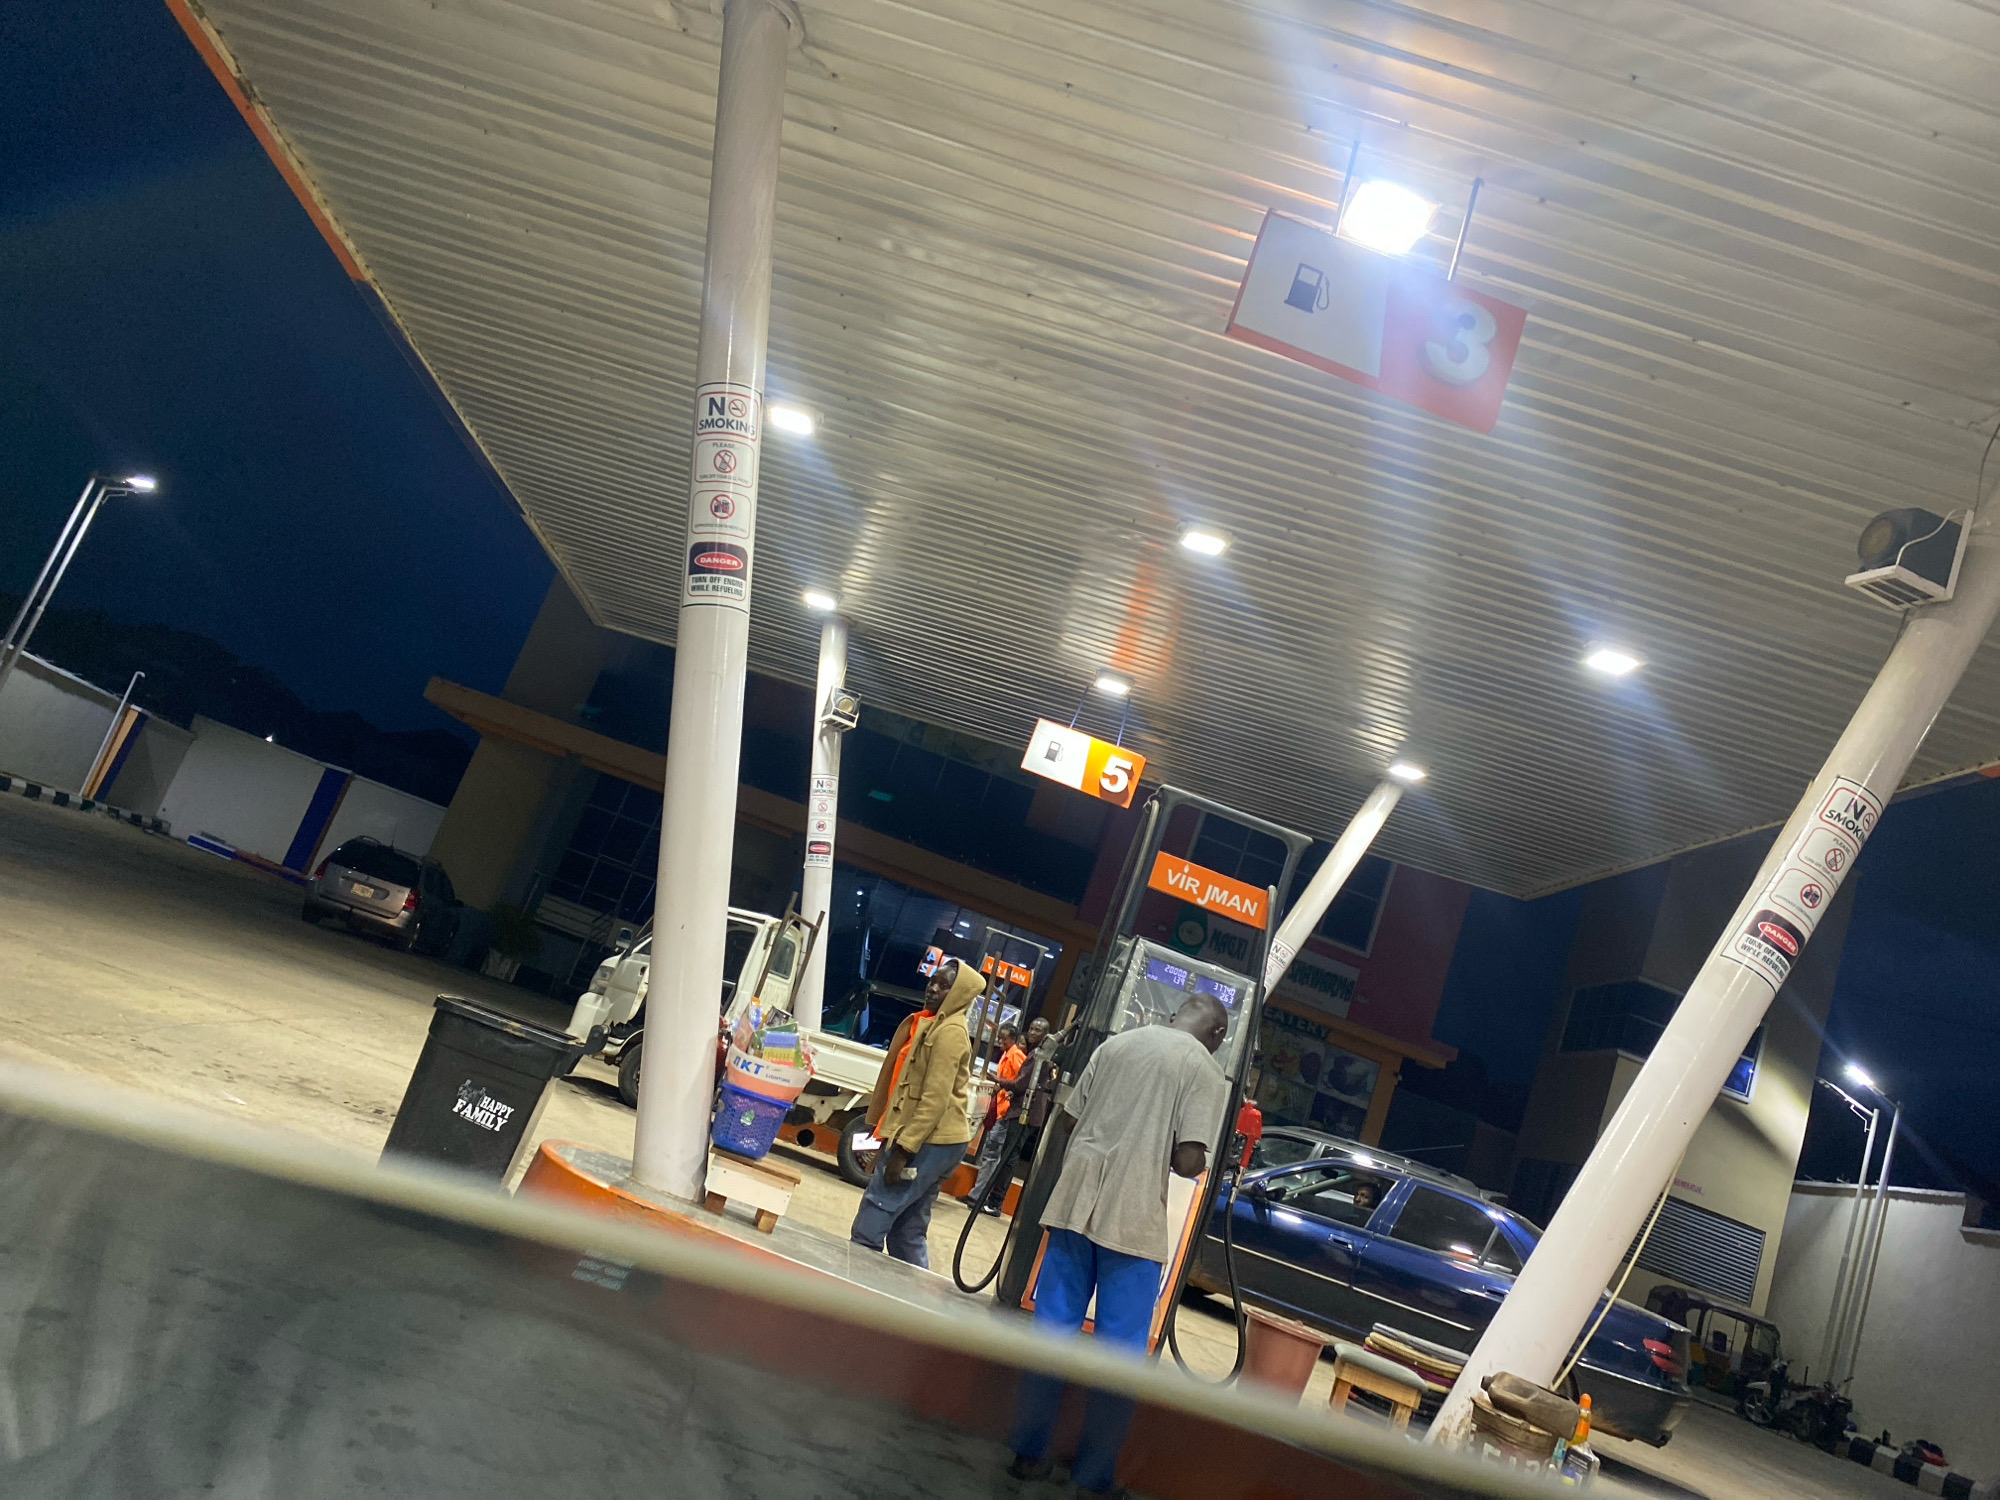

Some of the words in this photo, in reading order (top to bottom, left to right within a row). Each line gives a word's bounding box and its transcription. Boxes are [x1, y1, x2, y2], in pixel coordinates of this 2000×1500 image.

[1423, 299, 1497, 384] 3
[699, 417, 755, 435] SMOKING
[700, 556, 738, 567] DANGER
[709, 576, 721, 584] OFF
[1100, 755, 1133, 793] 5
[1763, 945, 1776, 958] OFF
[1764, 925, 1797, 953] DANGER
[1263, 1006, 1329, 1038] EATERY
[452, 1098, 508, 1132] FAMILY
[480, 1095, 515, 1119] HAPPY
